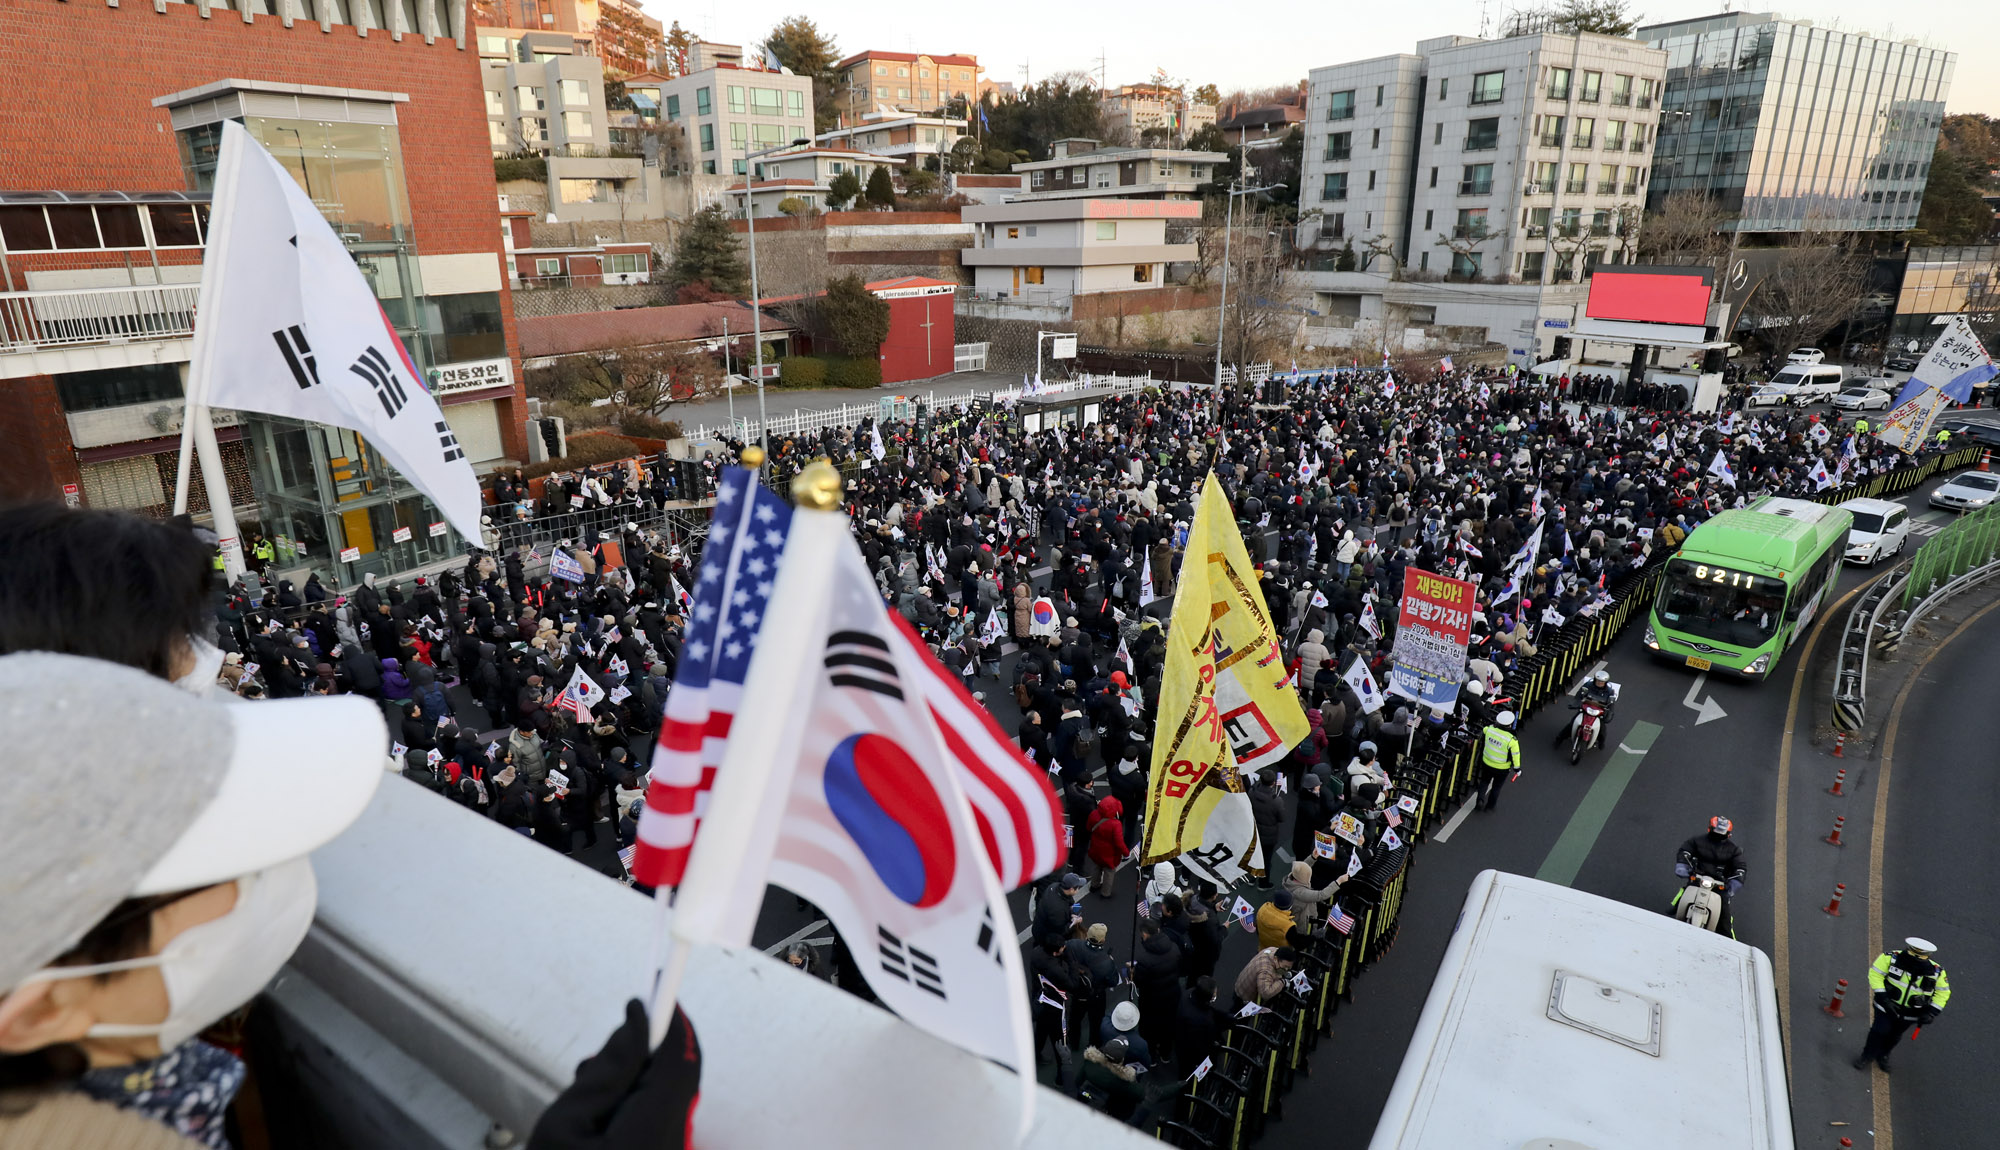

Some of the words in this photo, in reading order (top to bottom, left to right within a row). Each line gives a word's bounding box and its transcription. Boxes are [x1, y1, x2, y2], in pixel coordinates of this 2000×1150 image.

[883, 288, 920, 298] International
[438, 379, 482, 392] SHINDONG
[484, 376, 506, 385] WINE
[442, 364, 499, 382] 신동화인
[1903, 407, 1930, 452] 헌법수호
[1415, 574, 1464, 604] 재명아!
[1695, 565, 1754, 589] 6211
[1405, 595, 1469, 632] 깜빵가자!
[1401, 631, 1448, 655] 공직선거법위반
[1449, 646, 1462, 659] 1심
[1411, 622, 1432, 639] 2024.
[1445, 633, 1456, 645] 15
